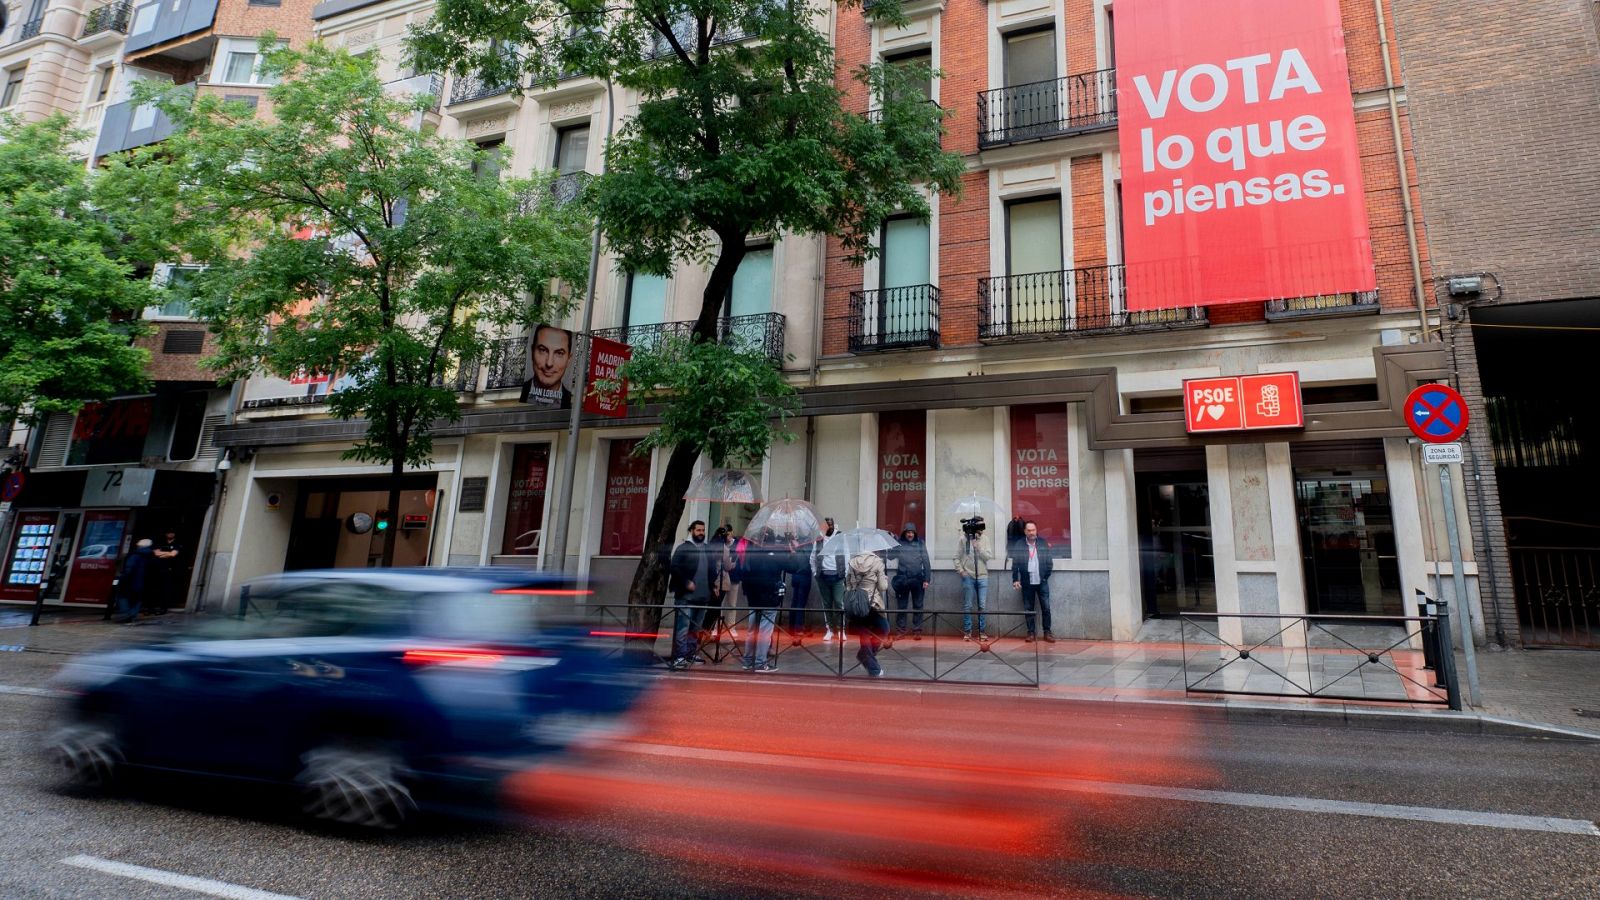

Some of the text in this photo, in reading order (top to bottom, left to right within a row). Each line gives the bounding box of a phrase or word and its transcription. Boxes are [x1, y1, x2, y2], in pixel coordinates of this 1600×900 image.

[1132, 47, 1322, 120] VOTA
[1141, 114, 1326, 173] lo que
[1143, 168, 1346, 226] piensas.
[597, 352, 625, 367] MADRID
[595, 364, 605, 378] DA
[543, 389, 563, 400] LOBATO
[1193, 387, 1235, 405] PSOE
[883, 454, 919, 466] VOTA
[1017, 449, 1057, 462] VOTA
[882, 467, 920, 481] lo que
[1016, 463, 1058, 478] lo que
[102, 470, 123, 492] 72
[610, 474, 644, 487] VOTA lo
[609, 487, 625, 496] que
